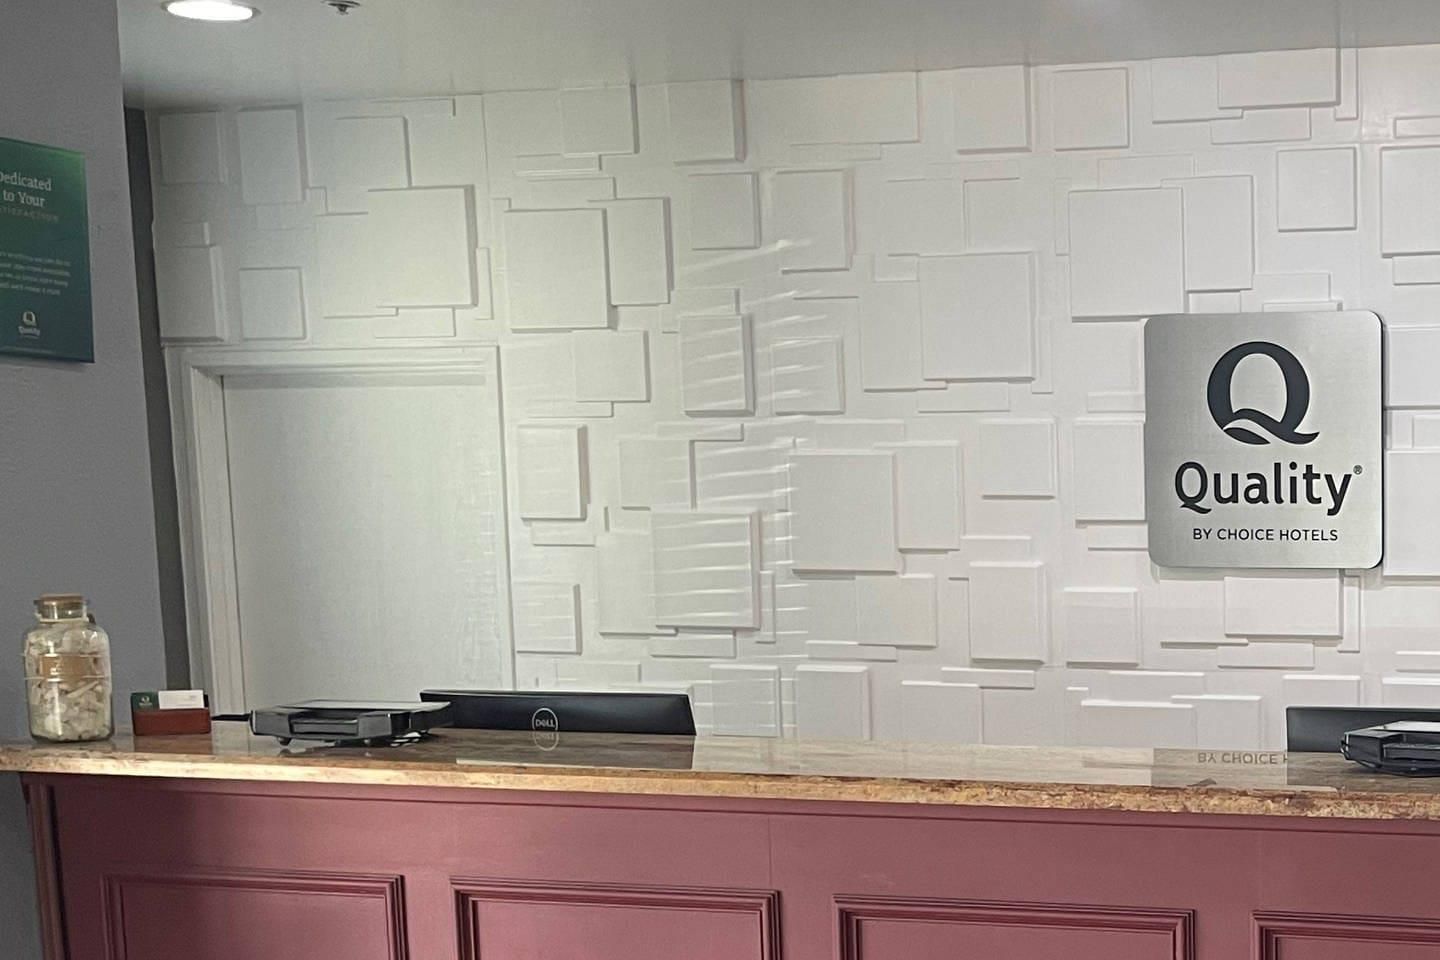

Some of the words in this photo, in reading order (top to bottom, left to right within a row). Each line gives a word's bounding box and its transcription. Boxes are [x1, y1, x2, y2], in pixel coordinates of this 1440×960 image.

[3, 189, 15, 202] to
[17, 191, 46, 208] Your
[1192, 527, 1212, 541] BY
[1217, 527, 1275, 541] CHOICE
[1279, 528, 1338, 542] HOTELS
[535, 719, 555, 728] DELL
